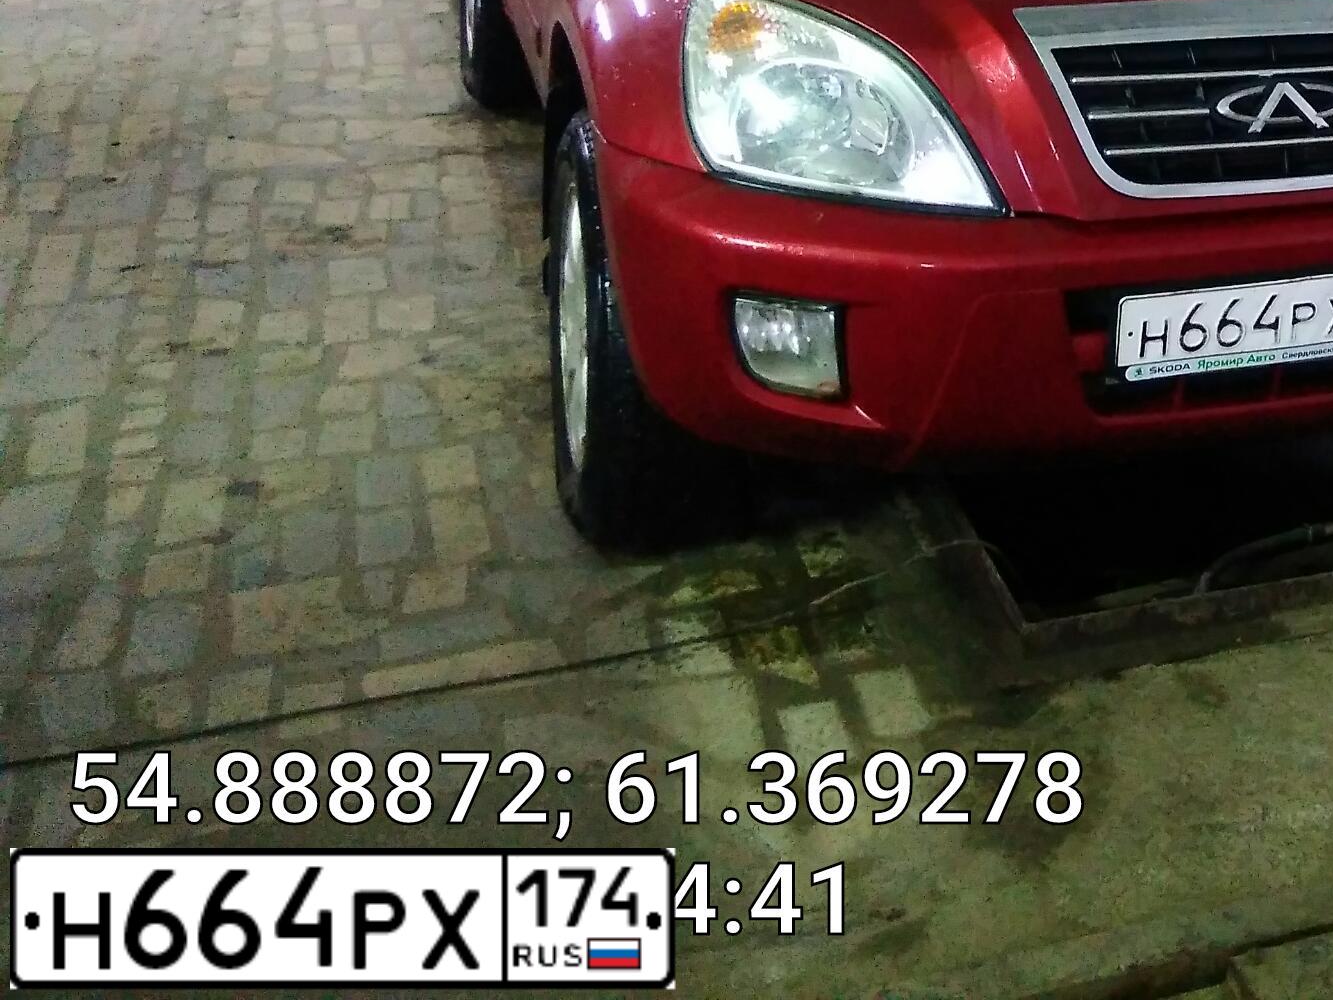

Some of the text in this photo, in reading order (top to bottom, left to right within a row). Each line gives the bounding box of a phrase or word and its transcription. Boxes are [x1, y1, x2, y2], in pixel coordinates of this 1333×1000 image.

[1149, 362, 1191, 375] SKODA
[1197, 357, 1244, 370] Яромир
[1246, 354, 1276, 364] Авто
